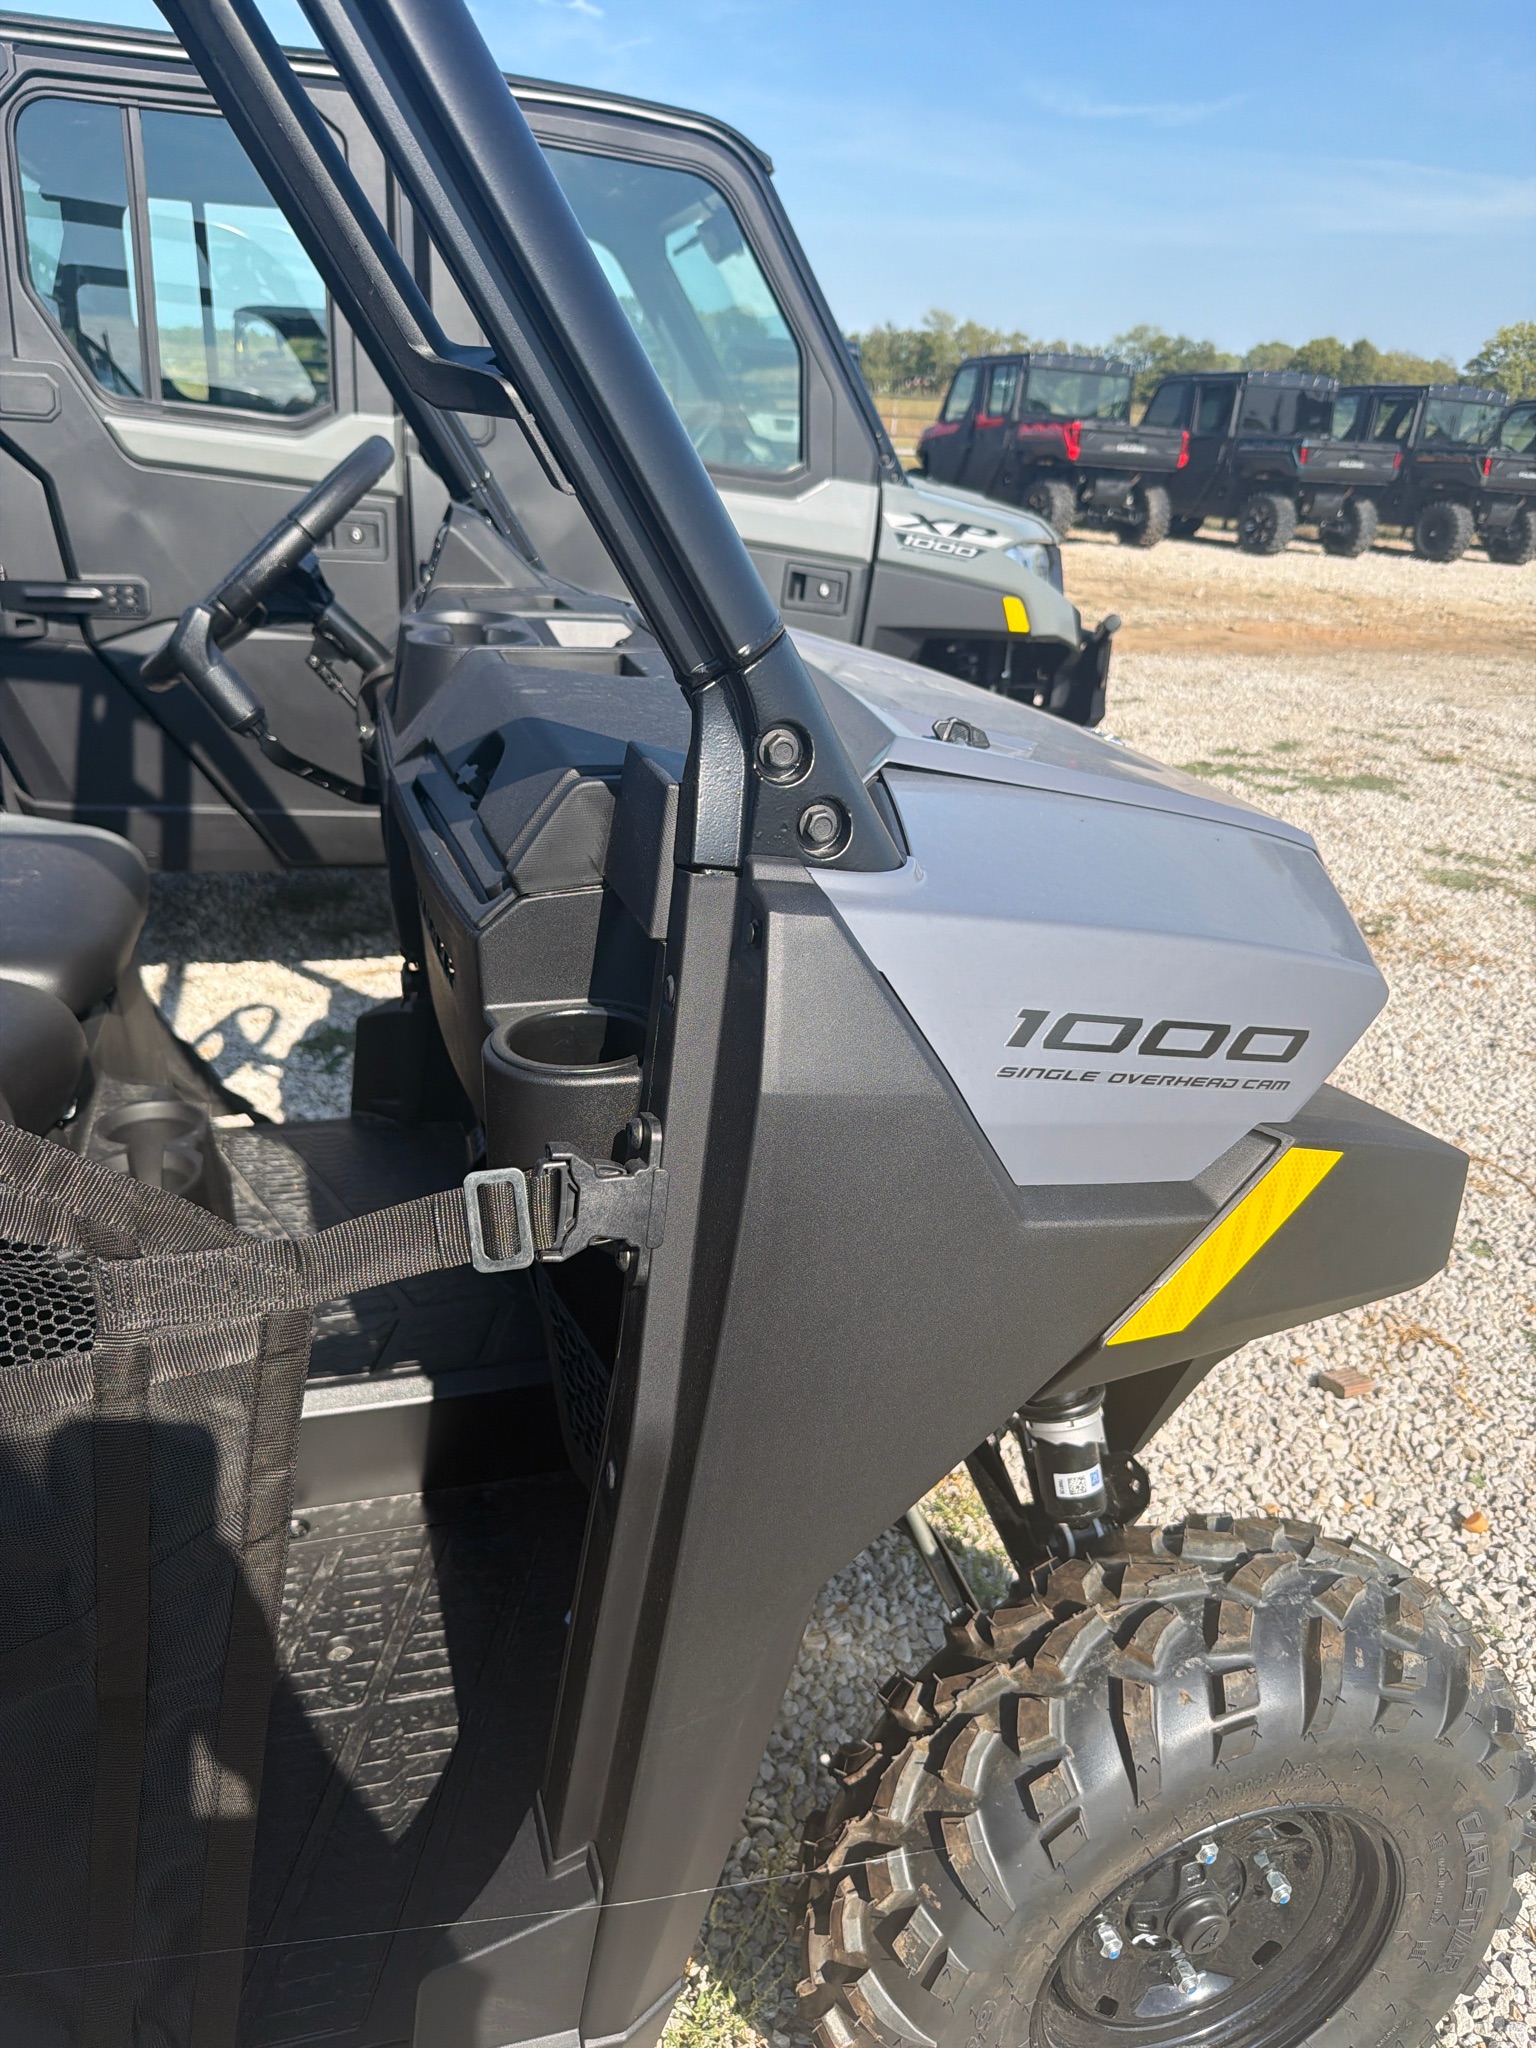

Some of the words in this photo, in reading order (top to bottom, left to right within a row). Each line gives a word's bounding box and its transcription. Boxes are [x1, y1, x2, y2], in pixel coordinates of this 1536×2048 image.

[896, 512, 997, 539] XP
[904, 534, 979, 558] 1000
[1003, 1008, 1310, 1063] 1000
[996, 1066, 1101, 1083] SINGLE
[1107, 1072, 1239, 1089] OVERHEAD
[1241, 1079, 1291, 1091] CAM
